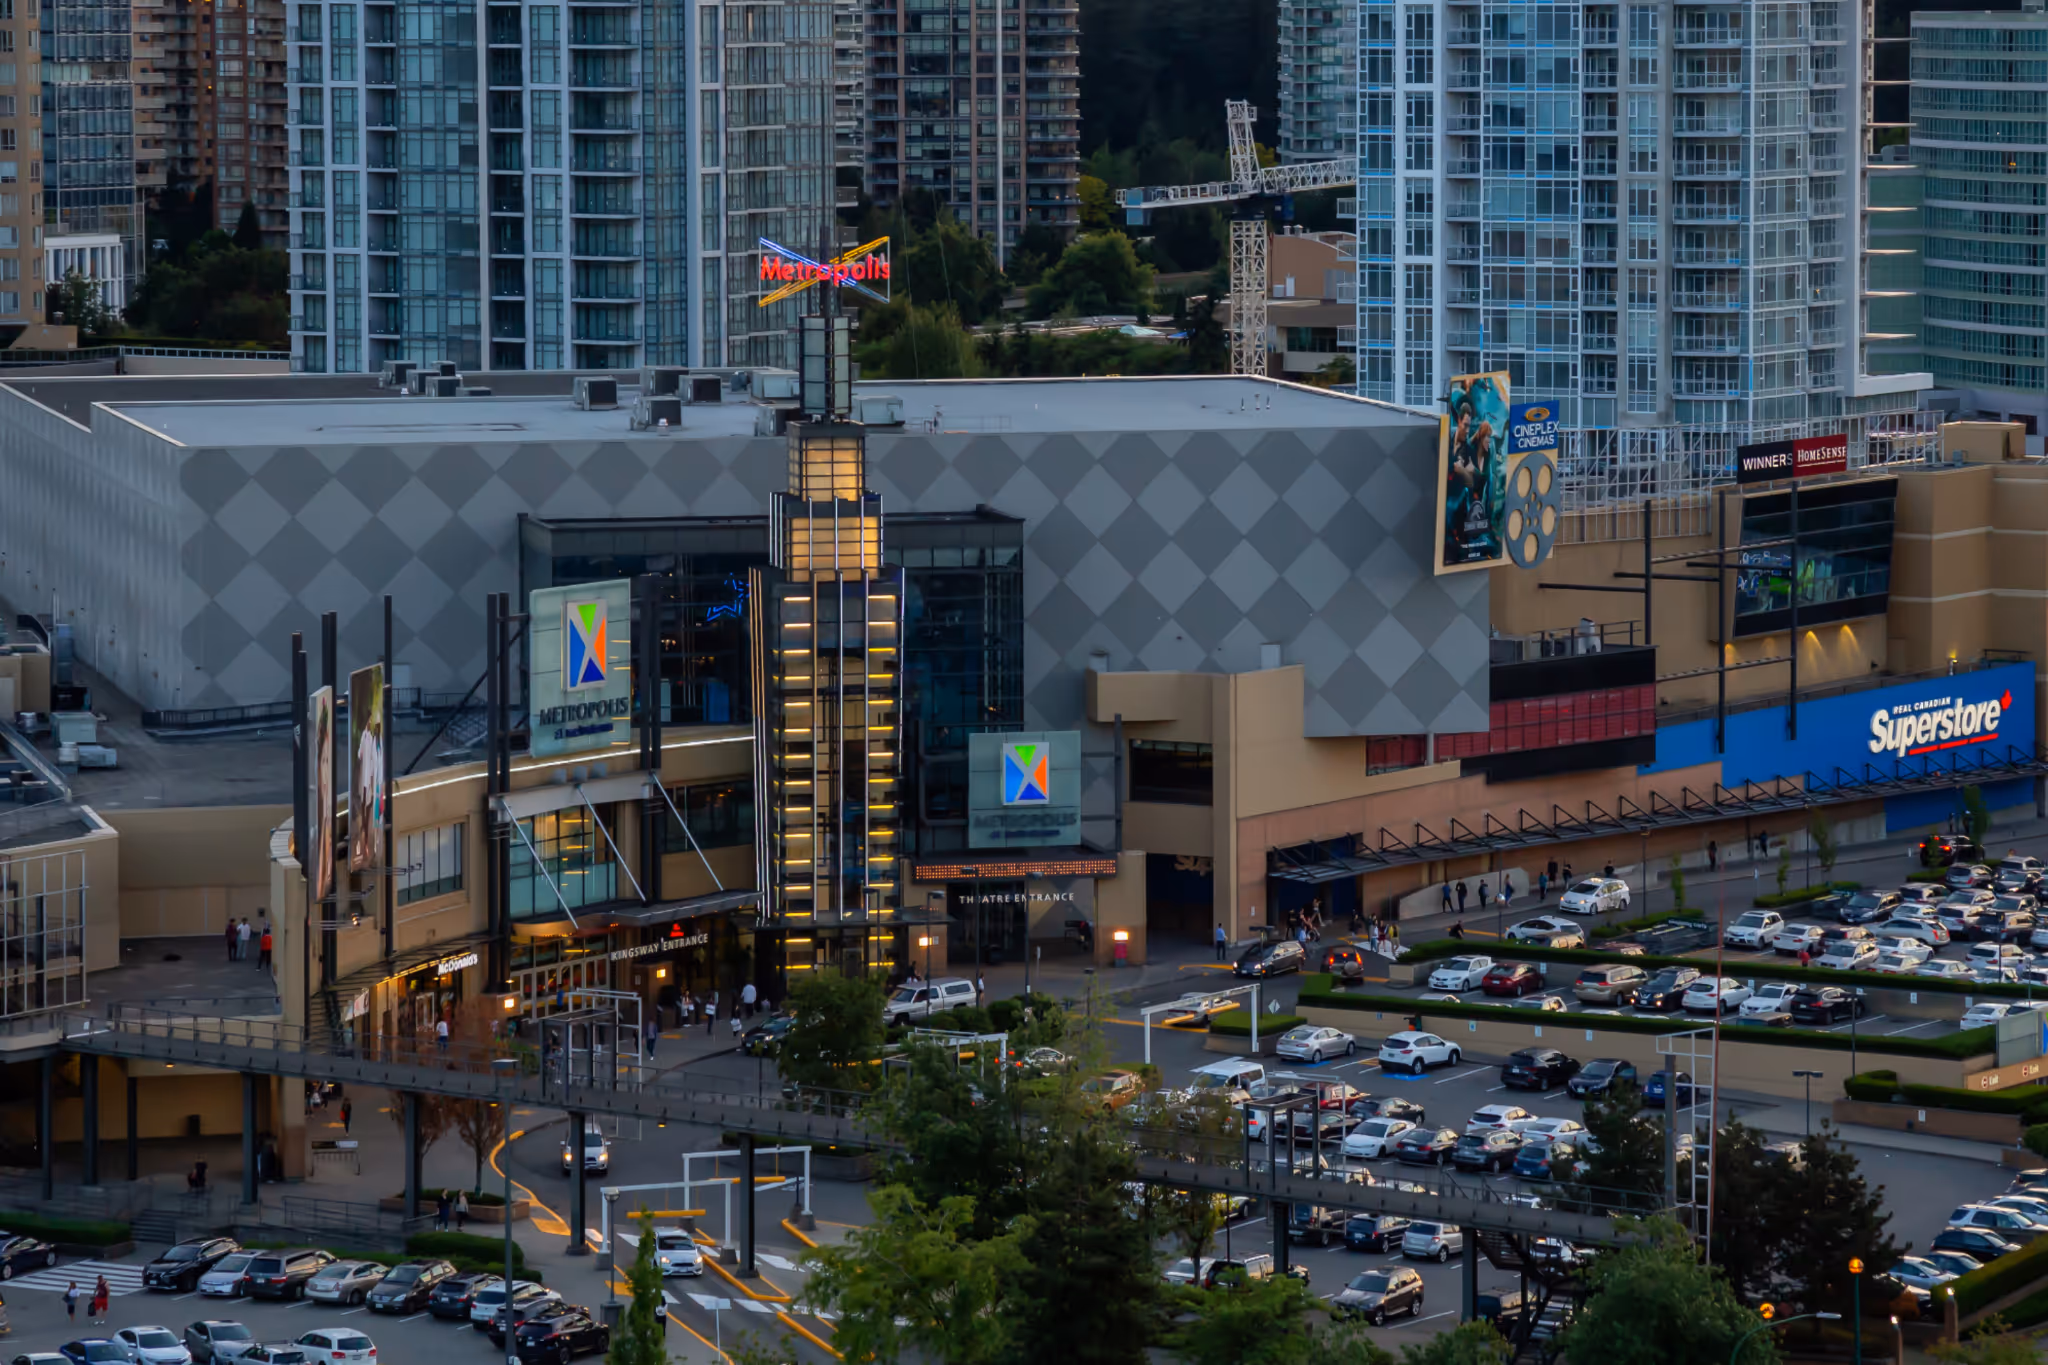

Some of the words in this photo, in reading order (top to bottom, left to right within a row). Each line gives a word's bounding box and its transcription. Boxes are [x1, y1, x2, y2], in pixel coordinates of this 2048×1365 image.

[760, 254, 891, 287] Metropolis
[1514, 420, 1560, 439] CINEPLEX
[1518, 434, 1555, 449] CINEMAS
[1743, 453, 1793, 471] WINNERS
[539, 697, 629, 726] METROPOLIS
[1893, 704, 1912, 715] REAL
[1914, 696, 1951, 711] CANADIAN
[1868, 697, 2001, 758] Superstore
[959, 894, 1010, 905] THATRE
[610, 943, 659, 961] KINGSWAY
[663, 933, 709, 951] ENTRANCE
[437, 953, 478, 976] McDonald's
